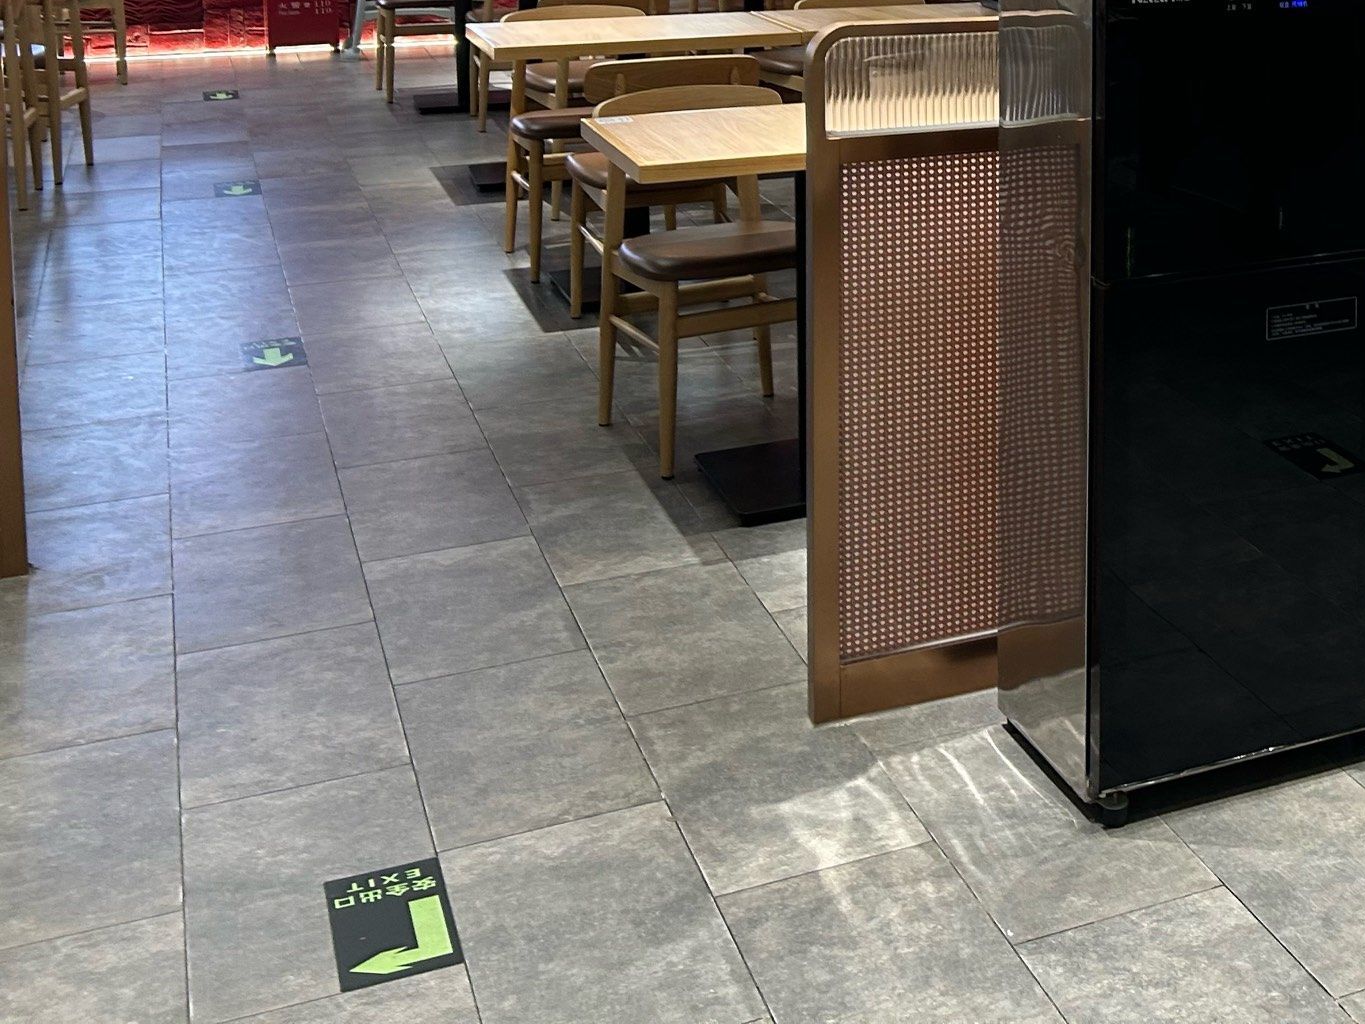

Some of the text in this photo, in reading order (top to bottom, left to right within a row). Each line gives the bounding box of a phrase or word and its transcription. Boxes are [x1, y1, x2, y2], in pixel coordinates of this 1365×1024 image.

[334, 876, 436, 909] 安全出口
[347, 868, 421, 893] EXIT
